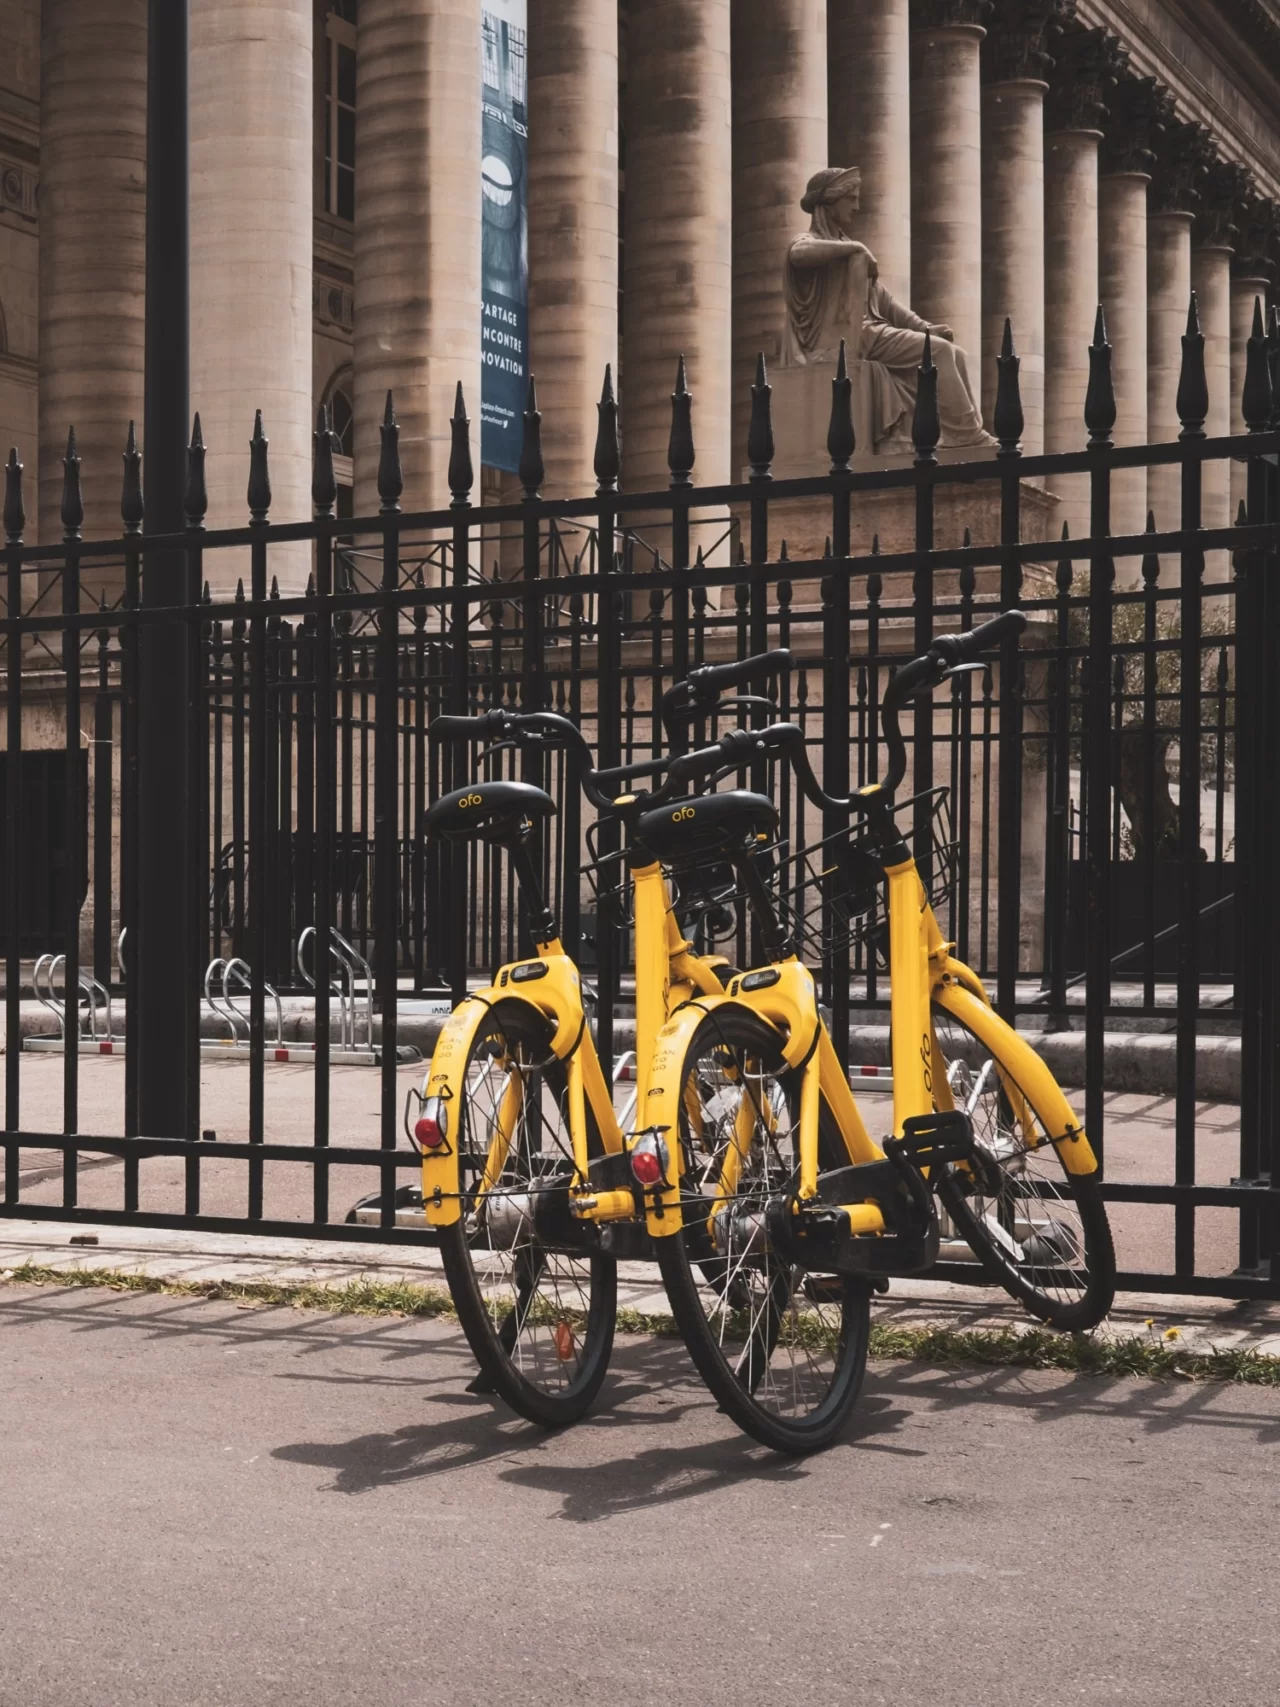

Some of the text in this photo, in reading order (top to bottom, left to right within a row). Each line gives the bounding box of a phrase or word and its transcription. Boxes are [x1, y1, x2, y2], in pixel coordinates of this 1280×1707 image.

[480, 301, 517, 327] PARTAGE
[482, 326, 522, 353] NCONTRE
[458, 793, 482, 808] ofo
[672, 806, 695, 822] ofo
[920, 1033, 932, 1093] ofo
